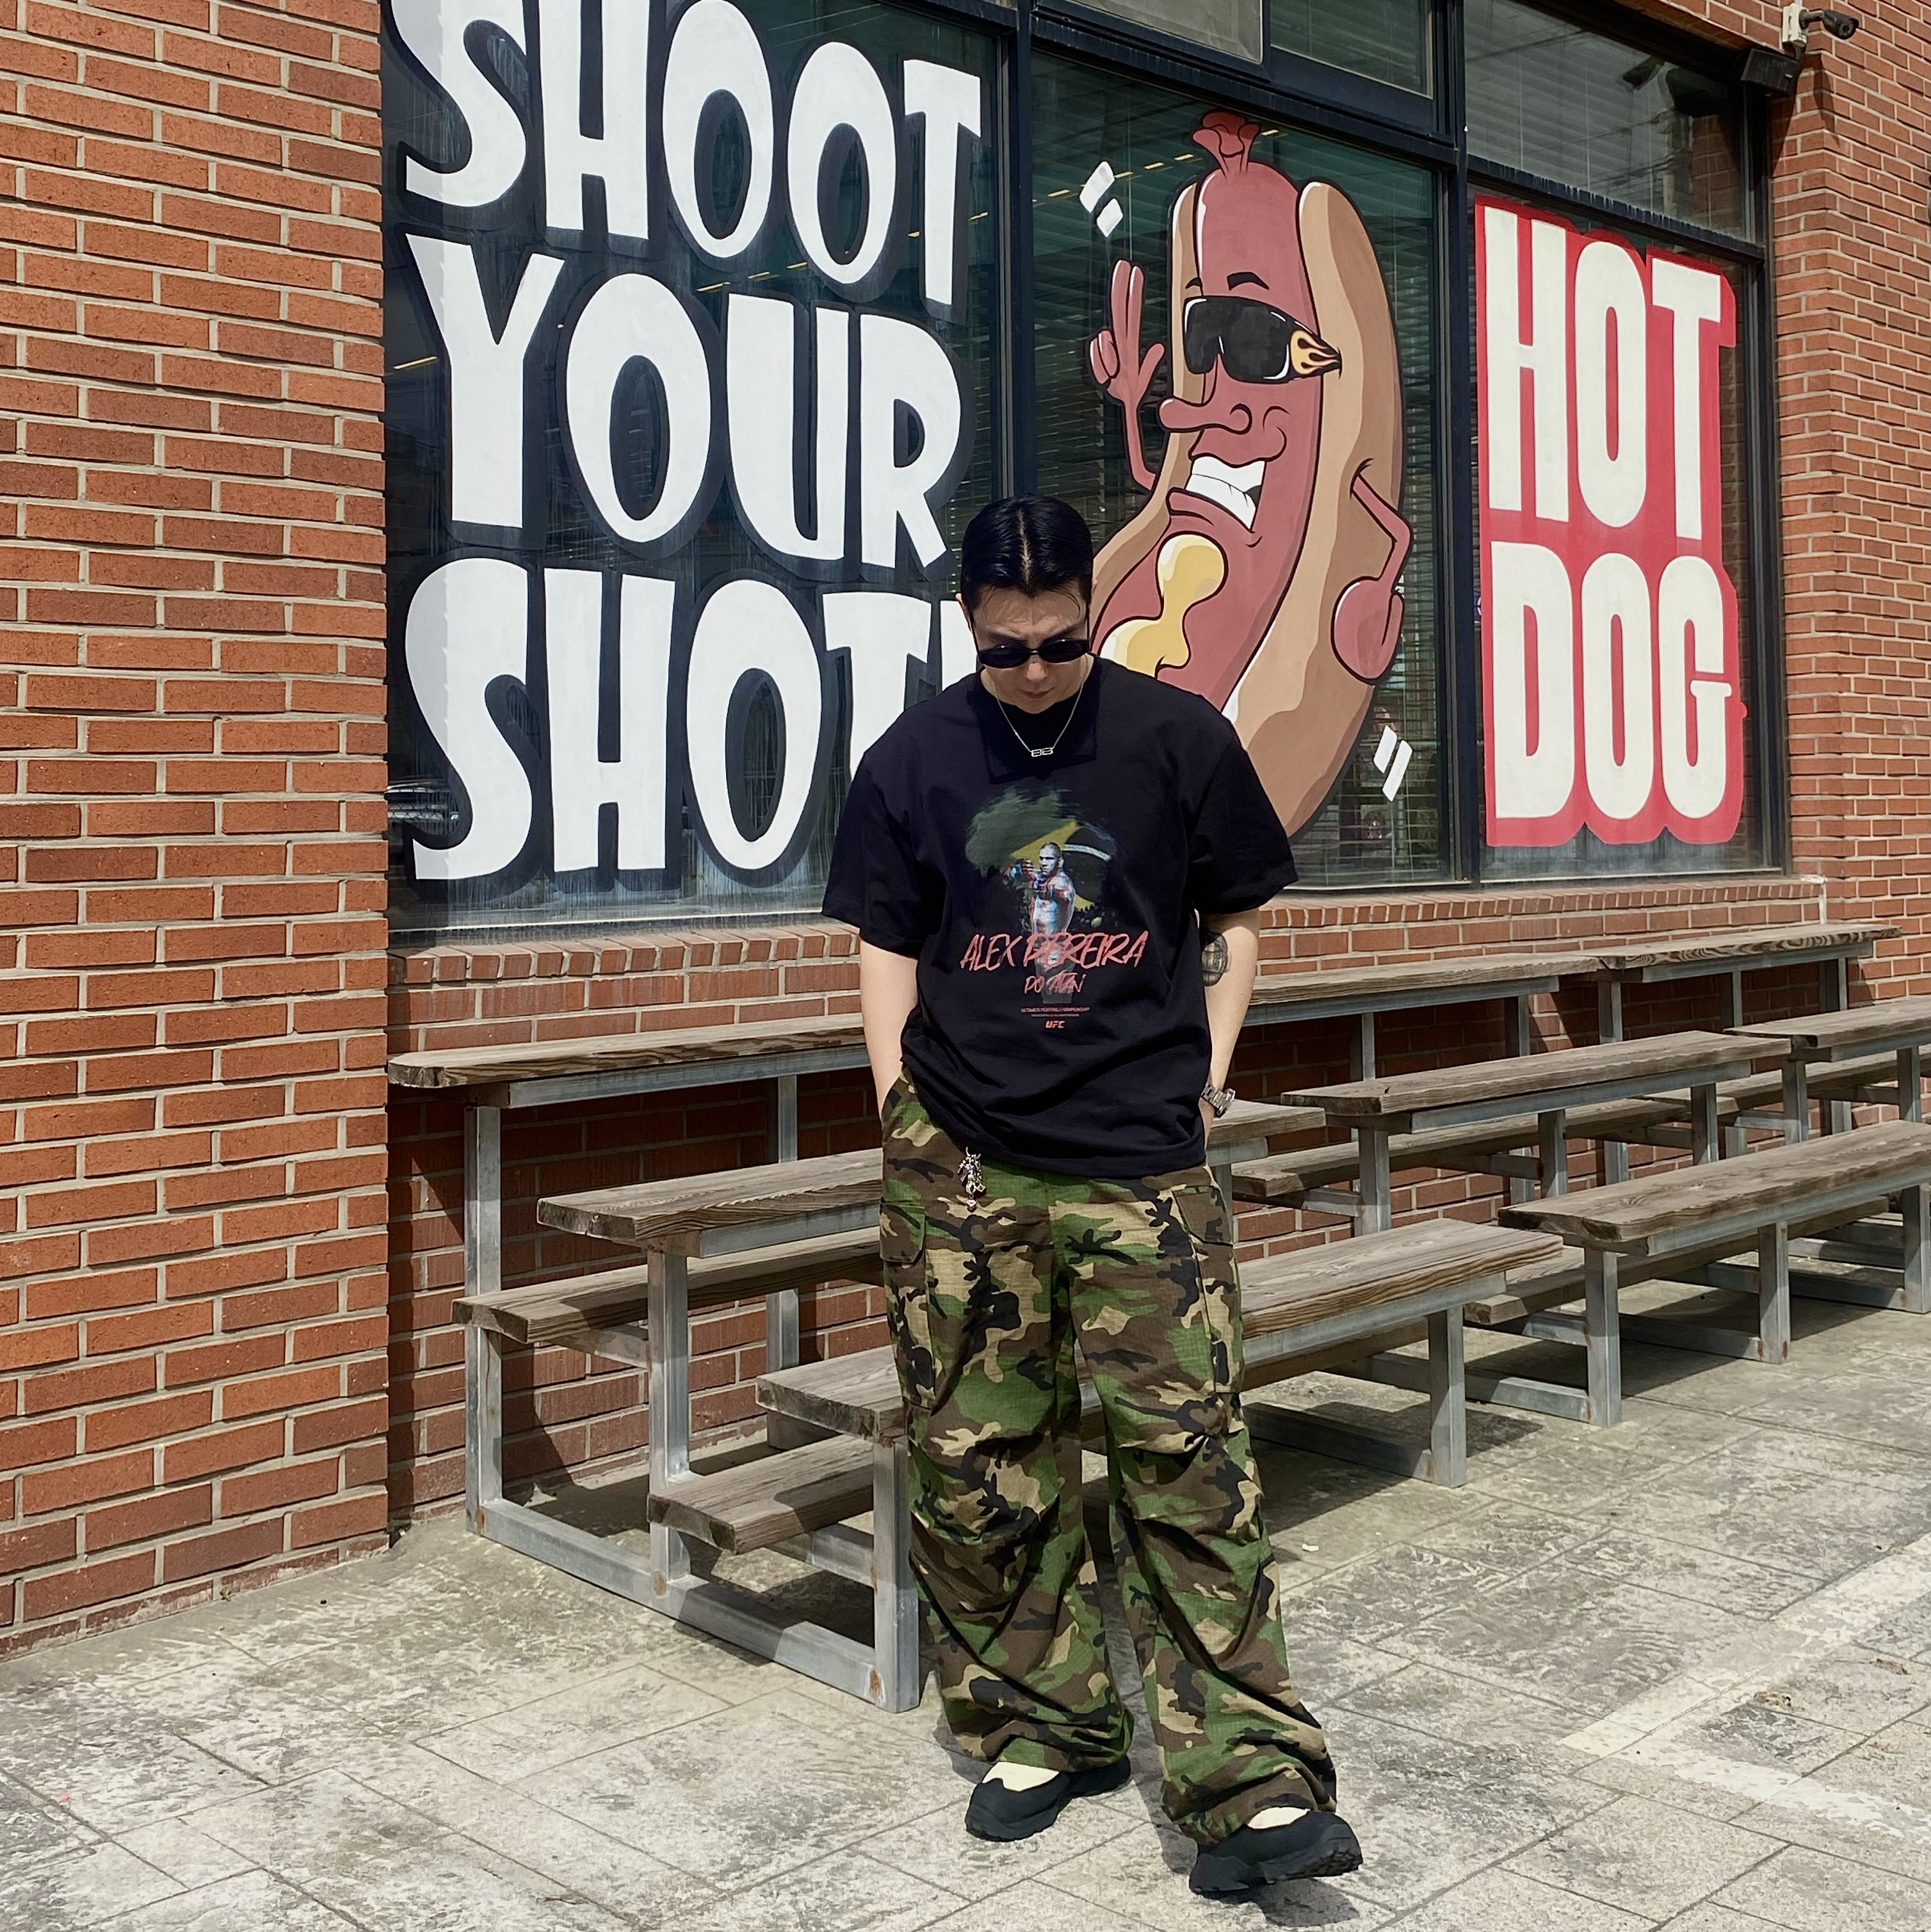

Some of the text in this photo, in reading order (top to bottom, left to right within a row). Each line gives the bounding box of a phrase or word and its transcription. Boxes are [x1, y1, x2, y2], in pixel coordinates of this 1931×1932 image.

[391, 0, 981, 305] SHOOT
[405, 233, 962, 569] YOUR
[1484, 206, 1721, 540] HOT
[1490, 540, 1733, 820] DOG
[960, 933, 1023, 971] ALEX
